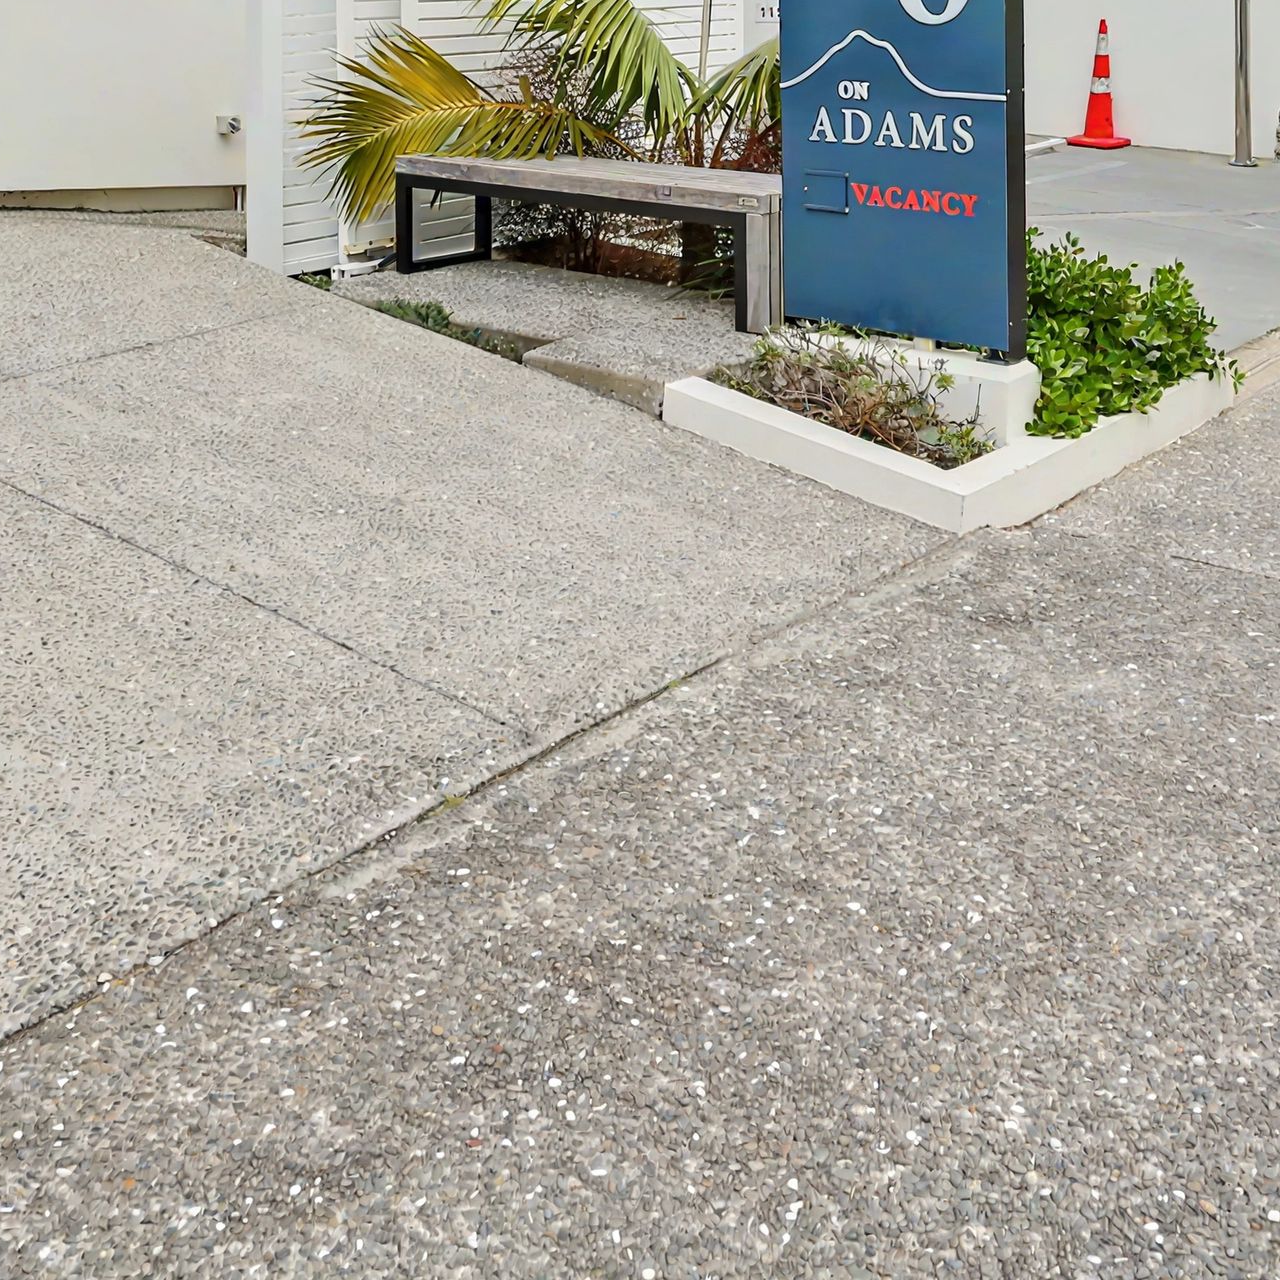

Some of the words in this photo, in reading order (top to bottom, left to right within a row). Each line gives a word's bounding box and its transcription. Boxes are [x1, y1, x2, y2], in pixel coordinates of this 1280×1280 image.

[837, 80, 870, 101] ON
[808, 105, 975, 154] ADAMS
[850, 182, 978, 217] VACANCY
